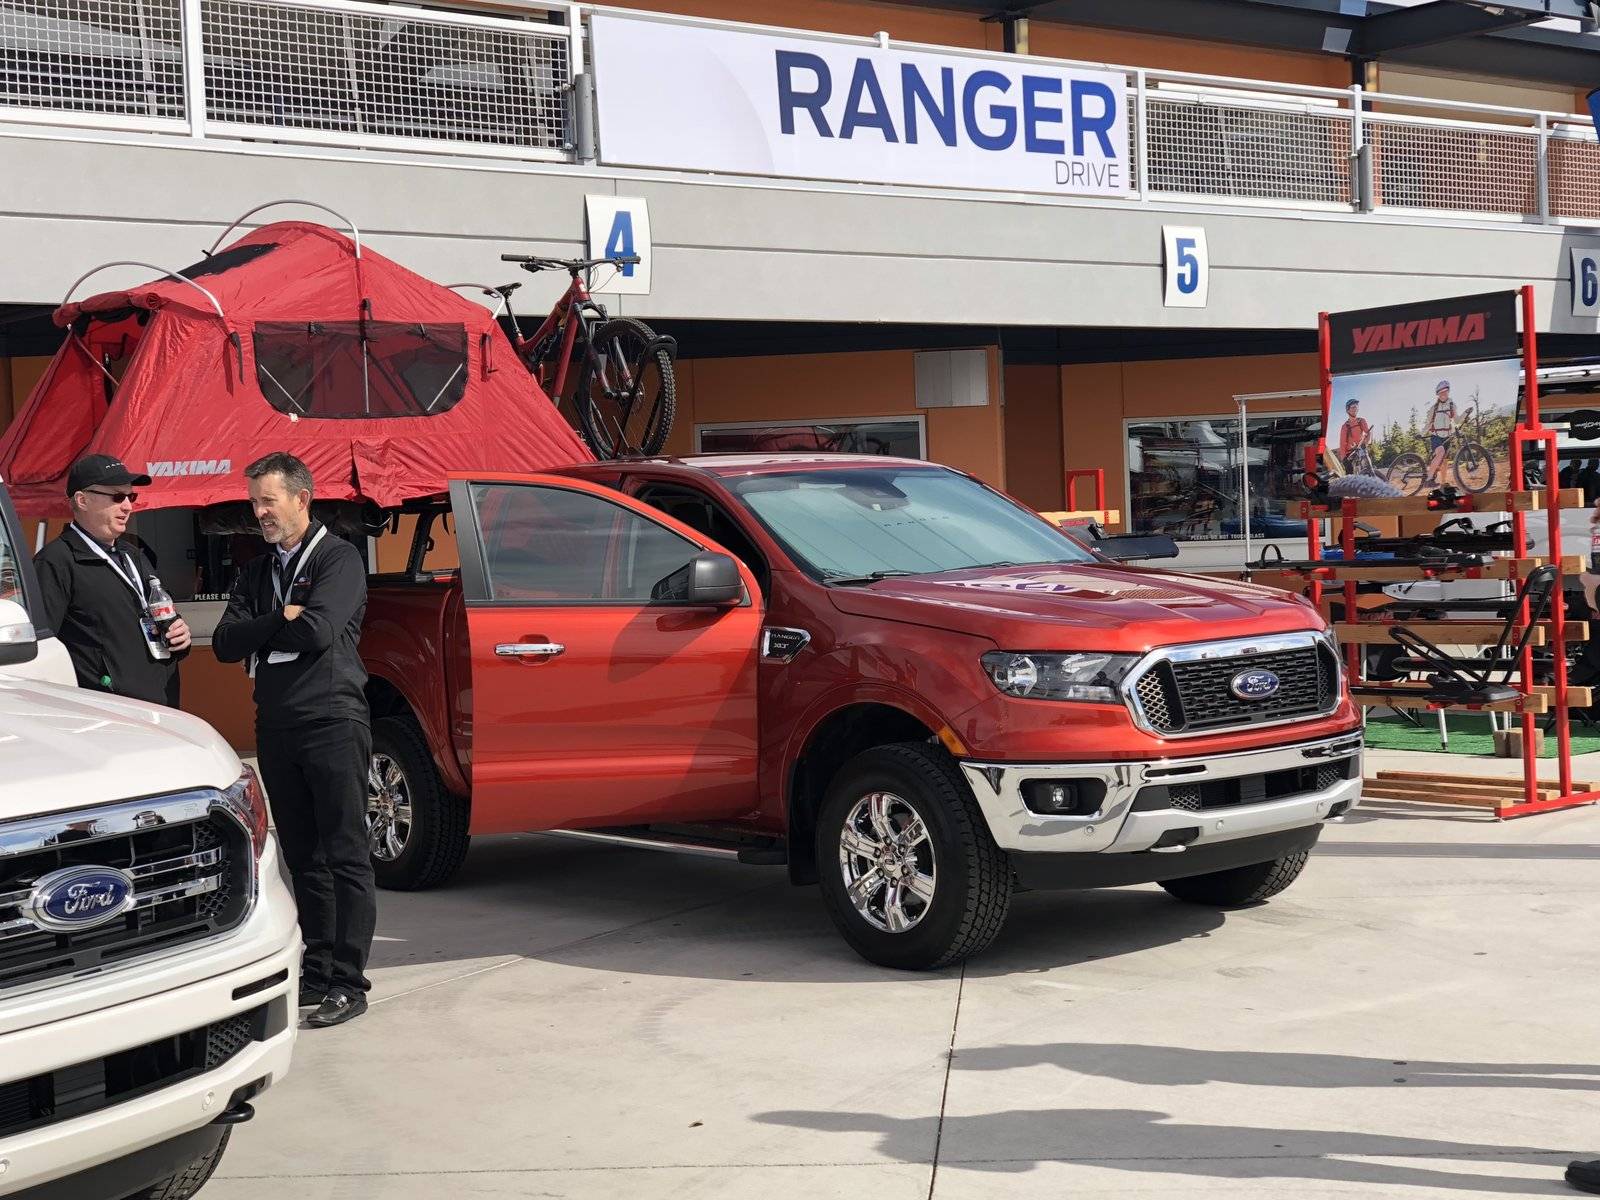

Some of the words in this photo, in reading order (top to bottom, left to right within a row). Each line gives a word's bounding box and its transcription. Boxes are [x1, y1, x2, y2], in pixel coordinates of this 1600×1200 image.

[775, 49, 1117, 159] RANGER
[1055, 159, 1120, 189] DRIVE
[604, 210, 635, 278] 4
[1176, 237, 1200, 295] 5
[1581, 257, 1599, 307] 6
[1352, 312, 1486, 354] YAKIMA
[146, 459, 231, 477] YAKIMA
[194, 593, 220, 601] PLEASE
[1246, 675, 1272, 692] Ford
[64, 880, 115, 915] Ford
